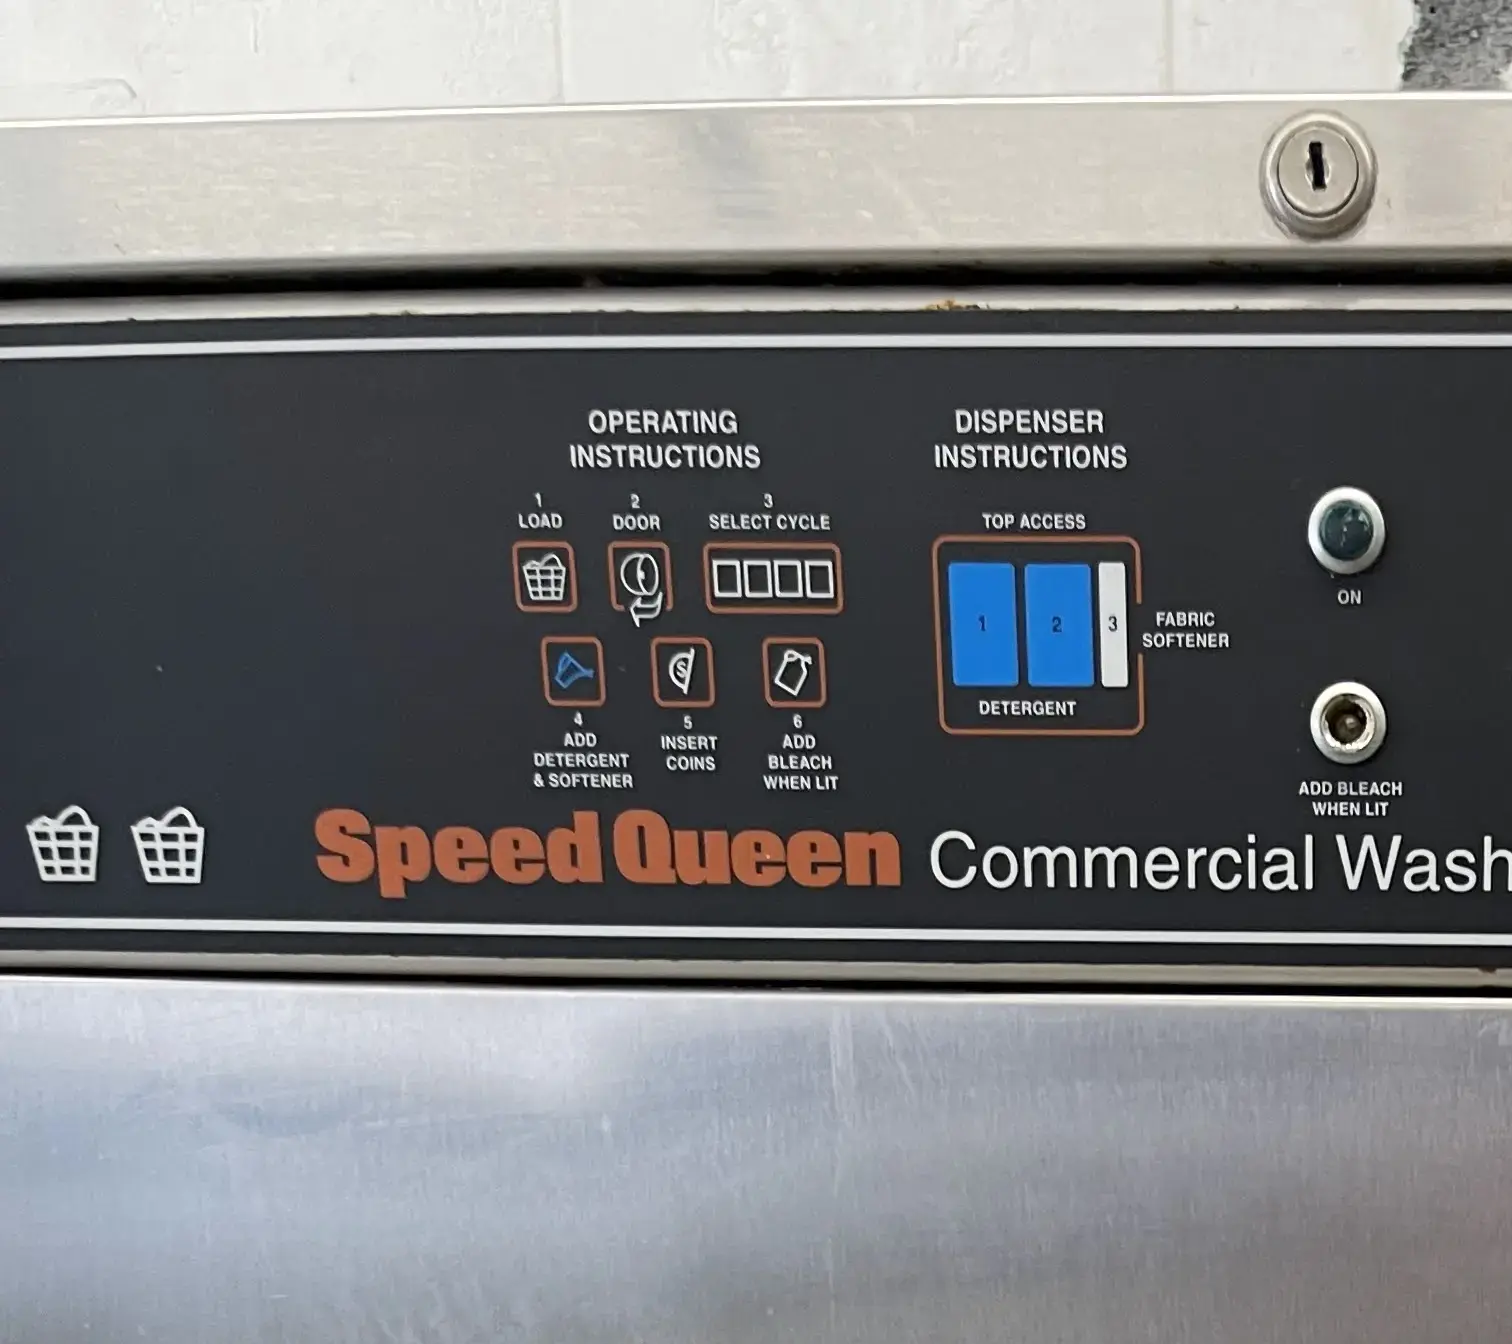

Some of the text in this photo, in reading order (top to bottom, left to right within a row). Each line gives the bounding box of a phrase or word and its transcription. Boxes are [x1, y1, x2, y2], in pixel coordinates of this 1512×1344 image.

[588, 410, 739, 435] OPERATING
[955, 410, 1105, 435] DISPENSER
[569, 444, 761, 470] INSTRUCTIONS
[934, 444, 1128, 470] INSTRUCTIONS
[534, 494, 543, 508] 1
[630, 495, 640, 509] 2
[763, 494, 773, 508] 3
[518, 514, 562, 530] LOAD
[612, 515, 660, 531] DOOR
[709, 514, 831, 531] SELECT CYCLE
[982, 514, 1086, 530] TOP ACCESS
[1338, 590, 1362, 605] ON
[979, 616, 986, 632] 1
[1052, 617, 1062, 633] 2
[1108, 616, 1118, 632] 3
[1156, 612, 1216, 628] FABRIC
[1143, 632, 1229, 649] SOFTENER
[979, 701, 1077, 716] DETERGENT
[574, 711, 583, 726] 4
[683, 715, 693, 730] 5
[793, 714, 803, 728] 6
[564, 733, 596, 747] ADD
[661, 736, 718, 750] INSERT
[782, 735, 816, 749] ADD
[534, 753, 629, 768] DETERGENT
[666, 756, 716, 771] COINS
[768, 755, 832, 770] BLEACH
[533, 773, 633, 788] & SOFTENER
[763, 776, 838, 790] WHEN LIT
[1299, 782, 1403, 796] ADD BLEACH
[1312, 802, 1389, 817] WHEN LIT
[314, 808, 604, 899] Speed
[612, 809, 902, 888] Queen
[929, 829, 1314, 892] Commercial
